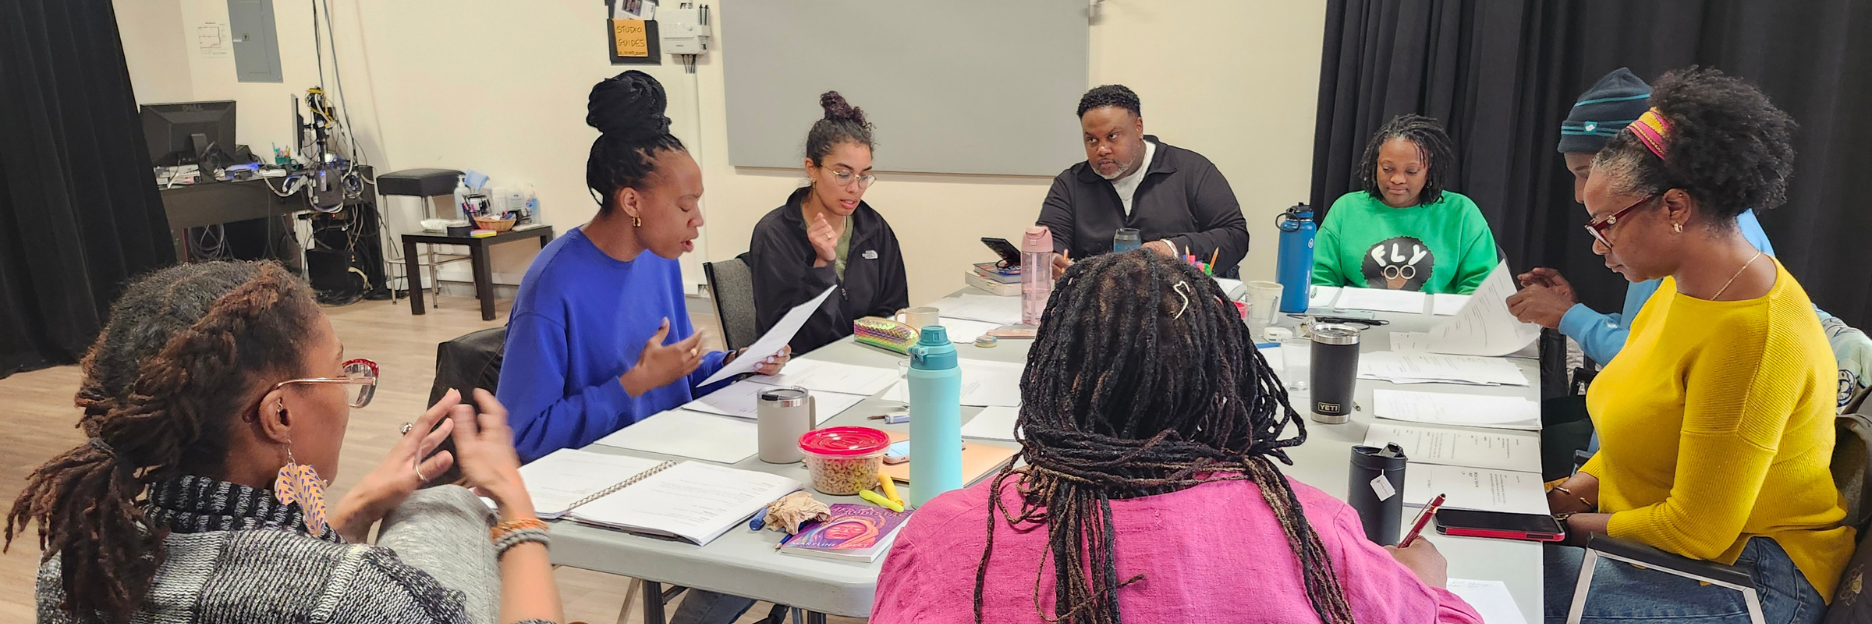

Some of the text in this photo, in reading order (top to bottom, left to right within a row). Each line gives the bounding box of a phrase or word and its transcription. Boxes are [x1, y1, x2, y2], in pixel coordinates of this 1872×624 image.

[616, 25, 642, 34] STUDIO
[618, 38, 645, 47] GUIDES
[1371, 243, 1427, 267] FLY
